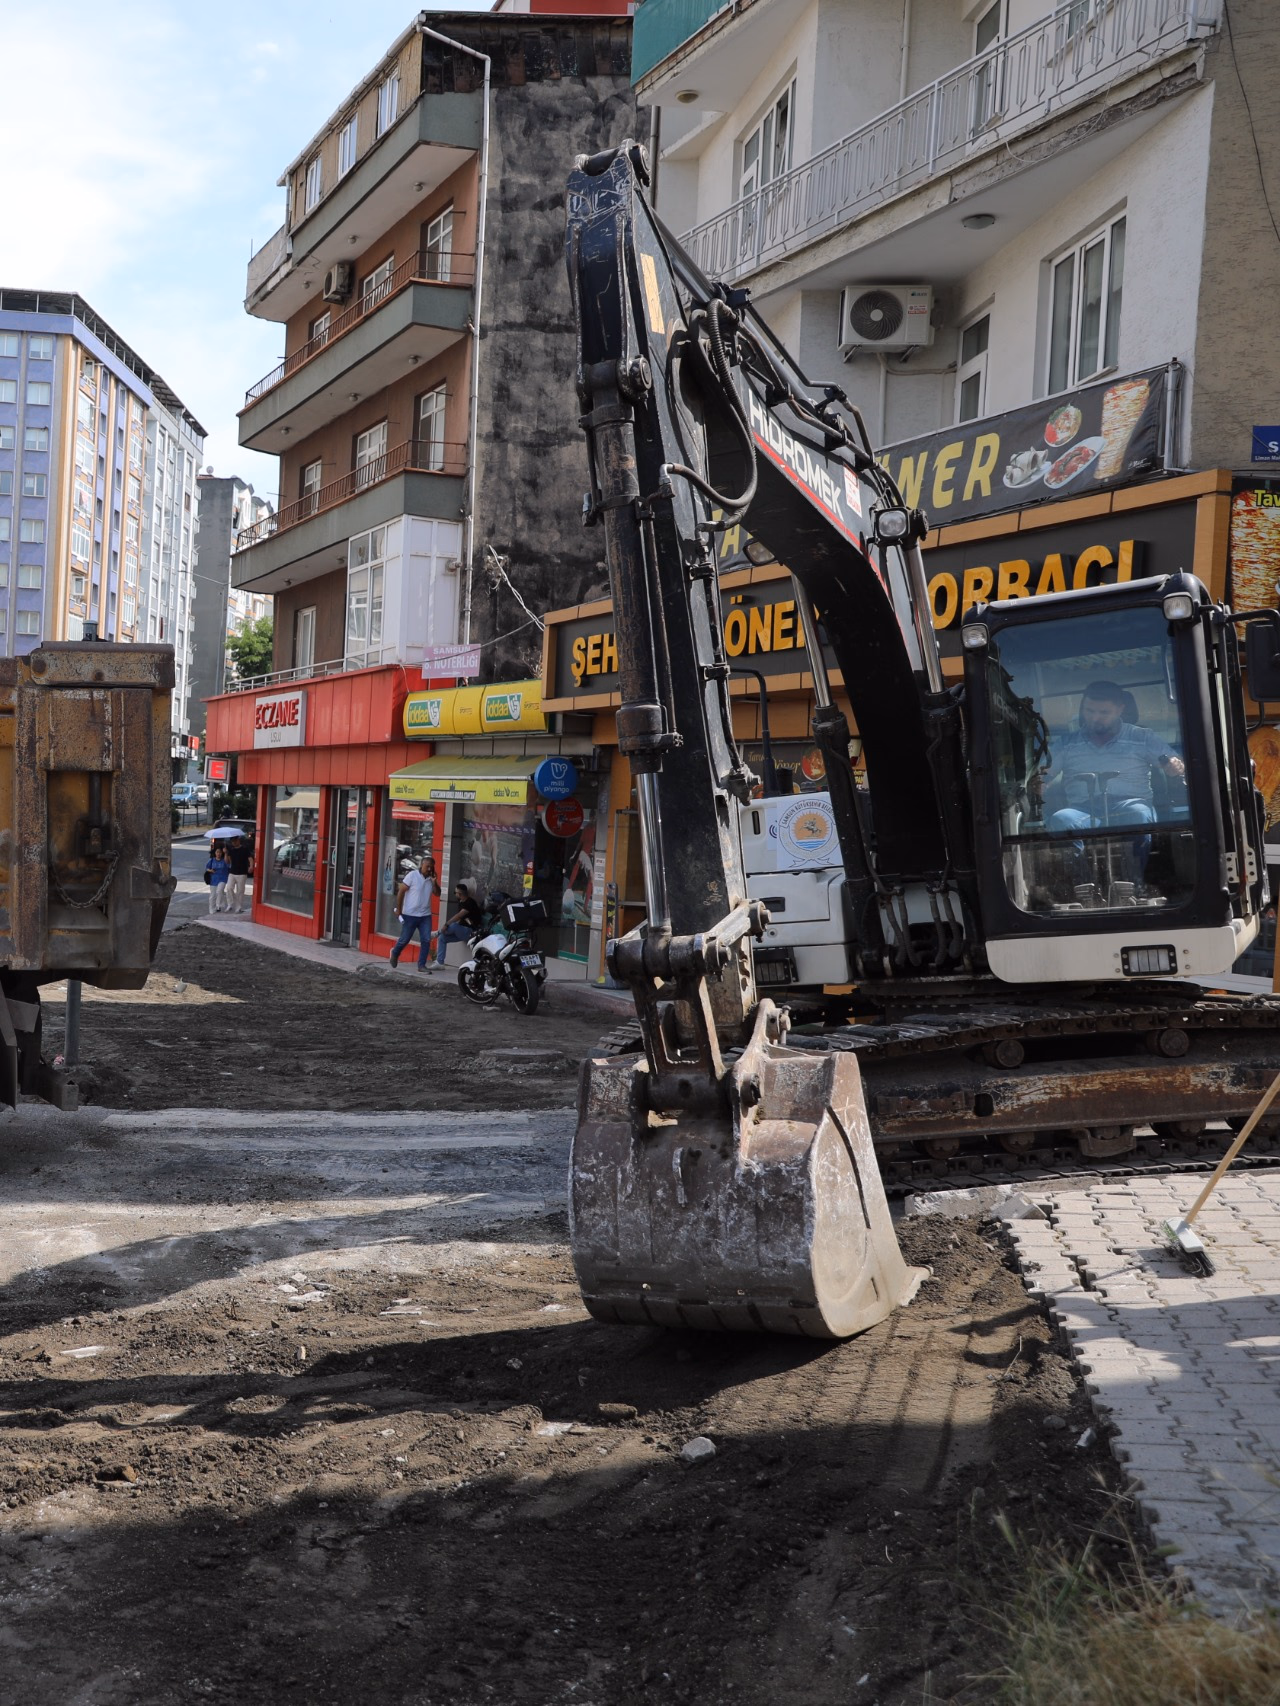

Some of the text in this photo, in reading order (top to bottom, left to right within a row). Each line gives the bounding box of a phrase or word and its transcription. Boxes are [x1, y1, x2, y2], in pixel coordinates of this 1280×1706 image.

[873, 432, 1000, 511] NER
[571, 540, 1135, 688] ŞEH ÖNE ORBACI
[433, 646, 471, 655] SAMSUN
[255, 698, 300, 730] ECZANE
[408, 704, 429, 725] iddaa
[486, 699, 509, 718] iddaa
[544, 786, 570, 794] piyango
